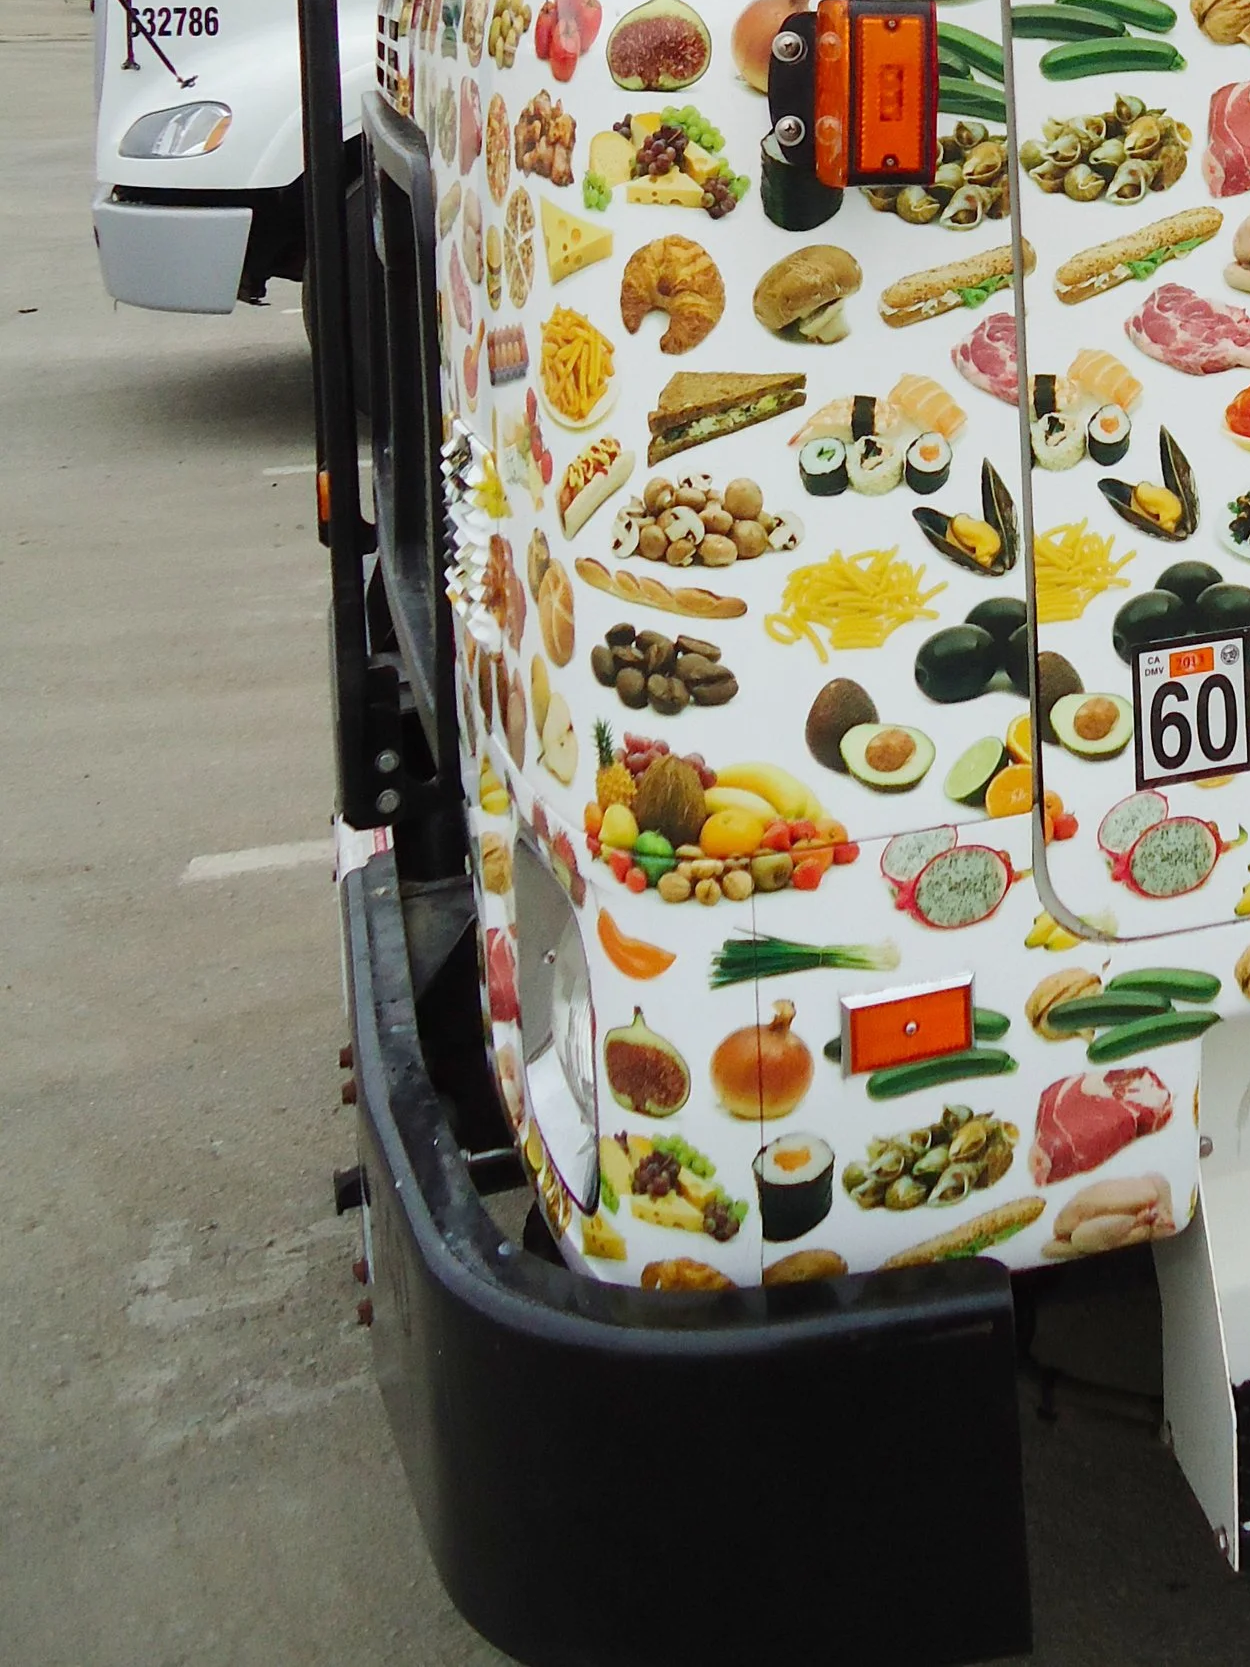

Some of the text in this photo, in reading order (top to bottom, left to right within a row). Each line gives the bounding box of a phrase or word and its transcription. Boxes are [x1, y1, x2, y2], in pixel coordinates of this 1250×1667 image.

[1147, 656, 1161, 666] CA
[1144, 666, 1165, 677] DMV
[1150, 674, 1238, 770] 60
